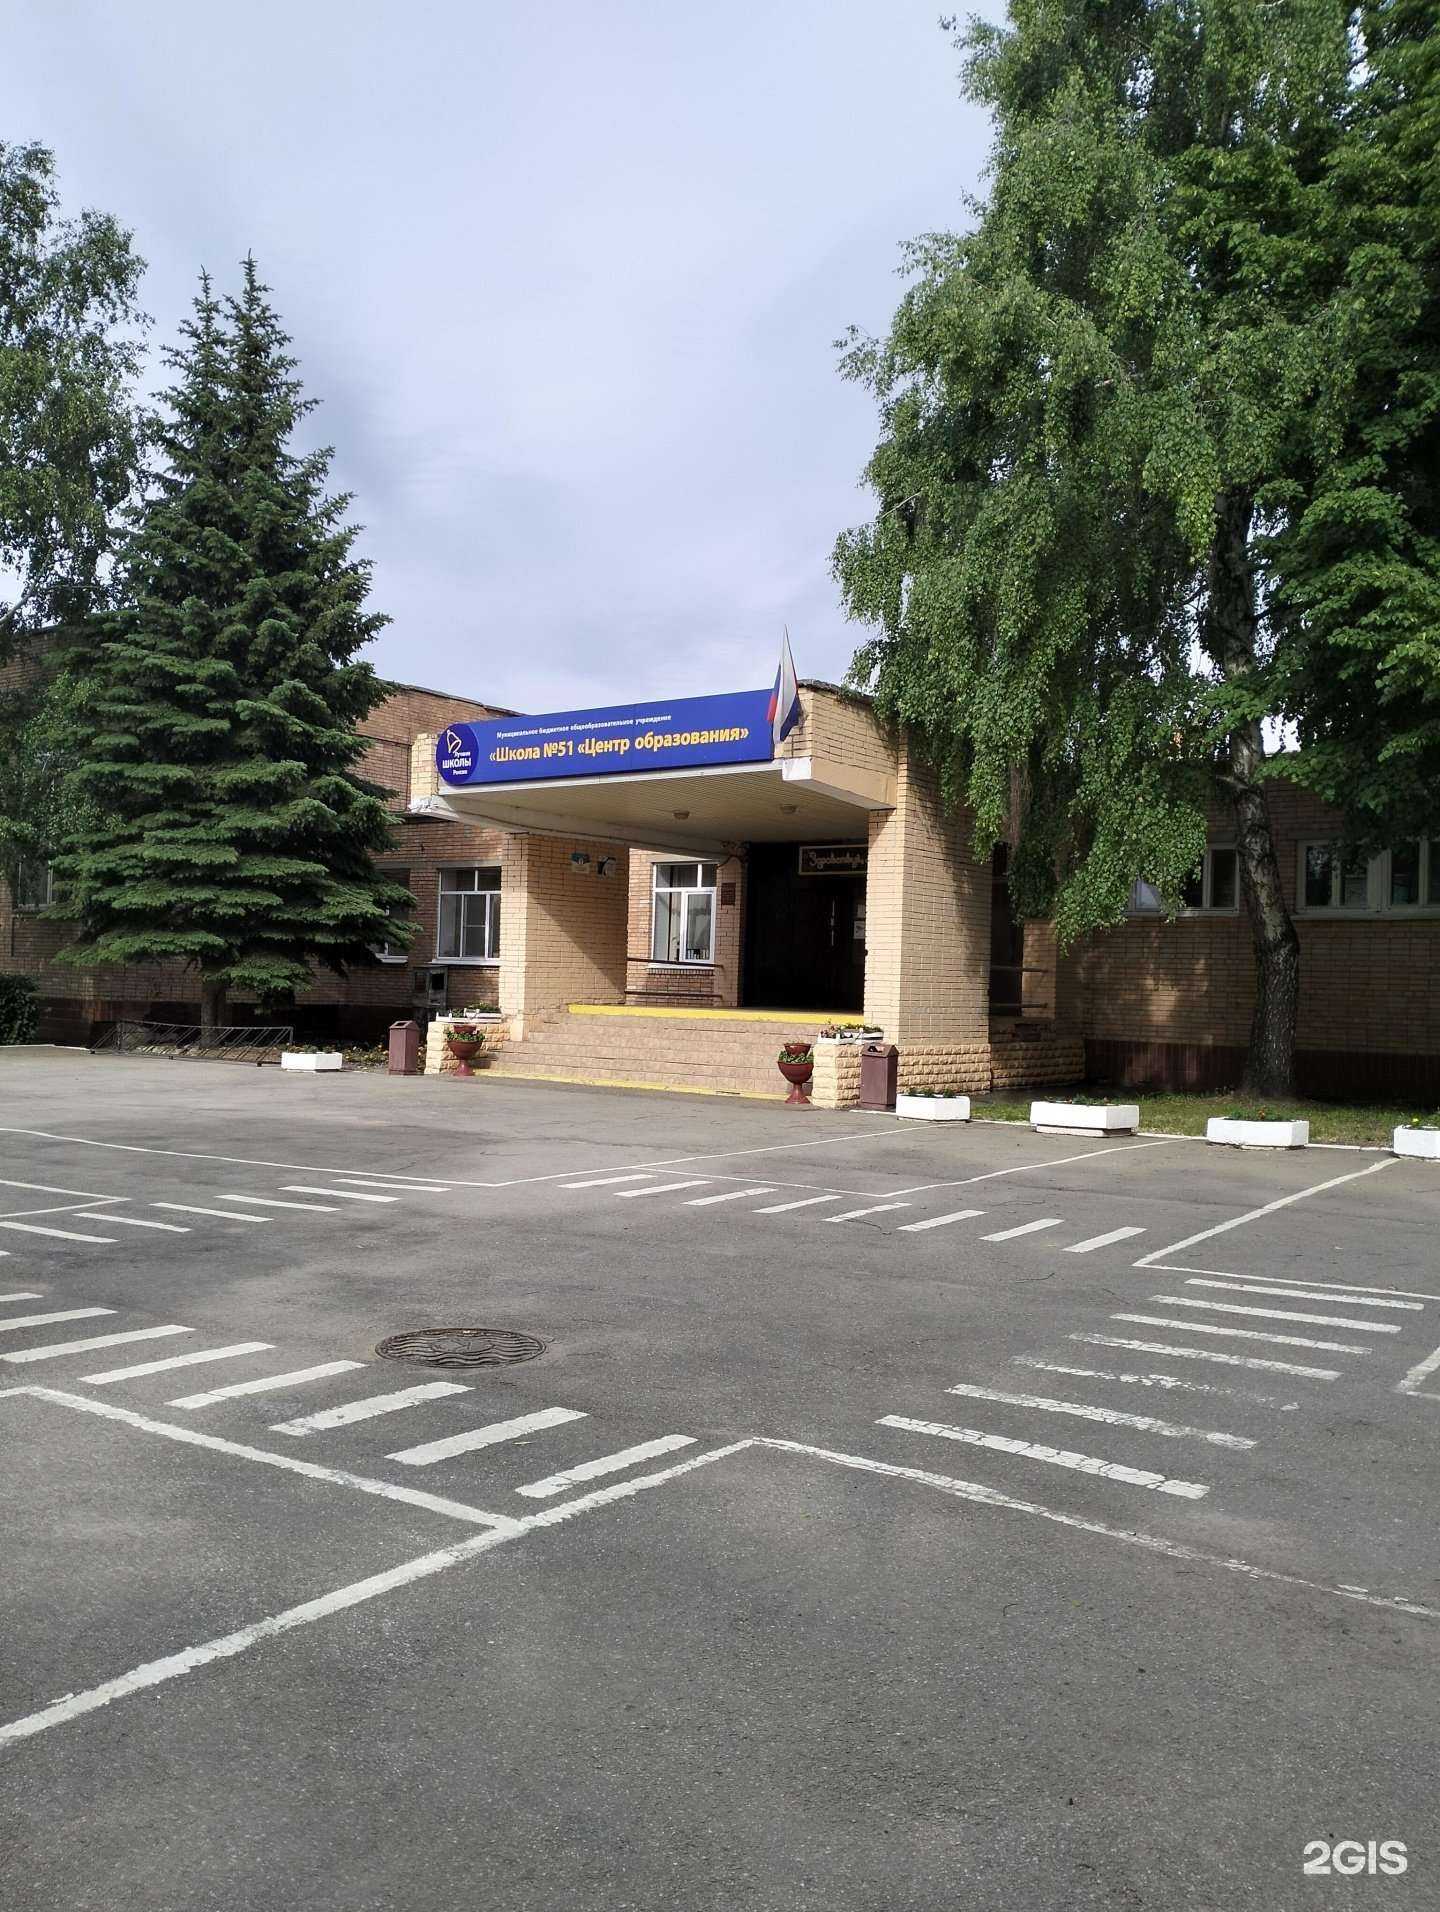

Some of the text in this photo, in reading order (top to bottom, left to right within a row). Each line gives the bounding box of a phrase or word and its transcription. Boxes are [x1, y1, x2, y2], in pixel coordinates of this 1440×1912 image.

[489, 728, 749, 761] «Школа №51 «Центр образования»
